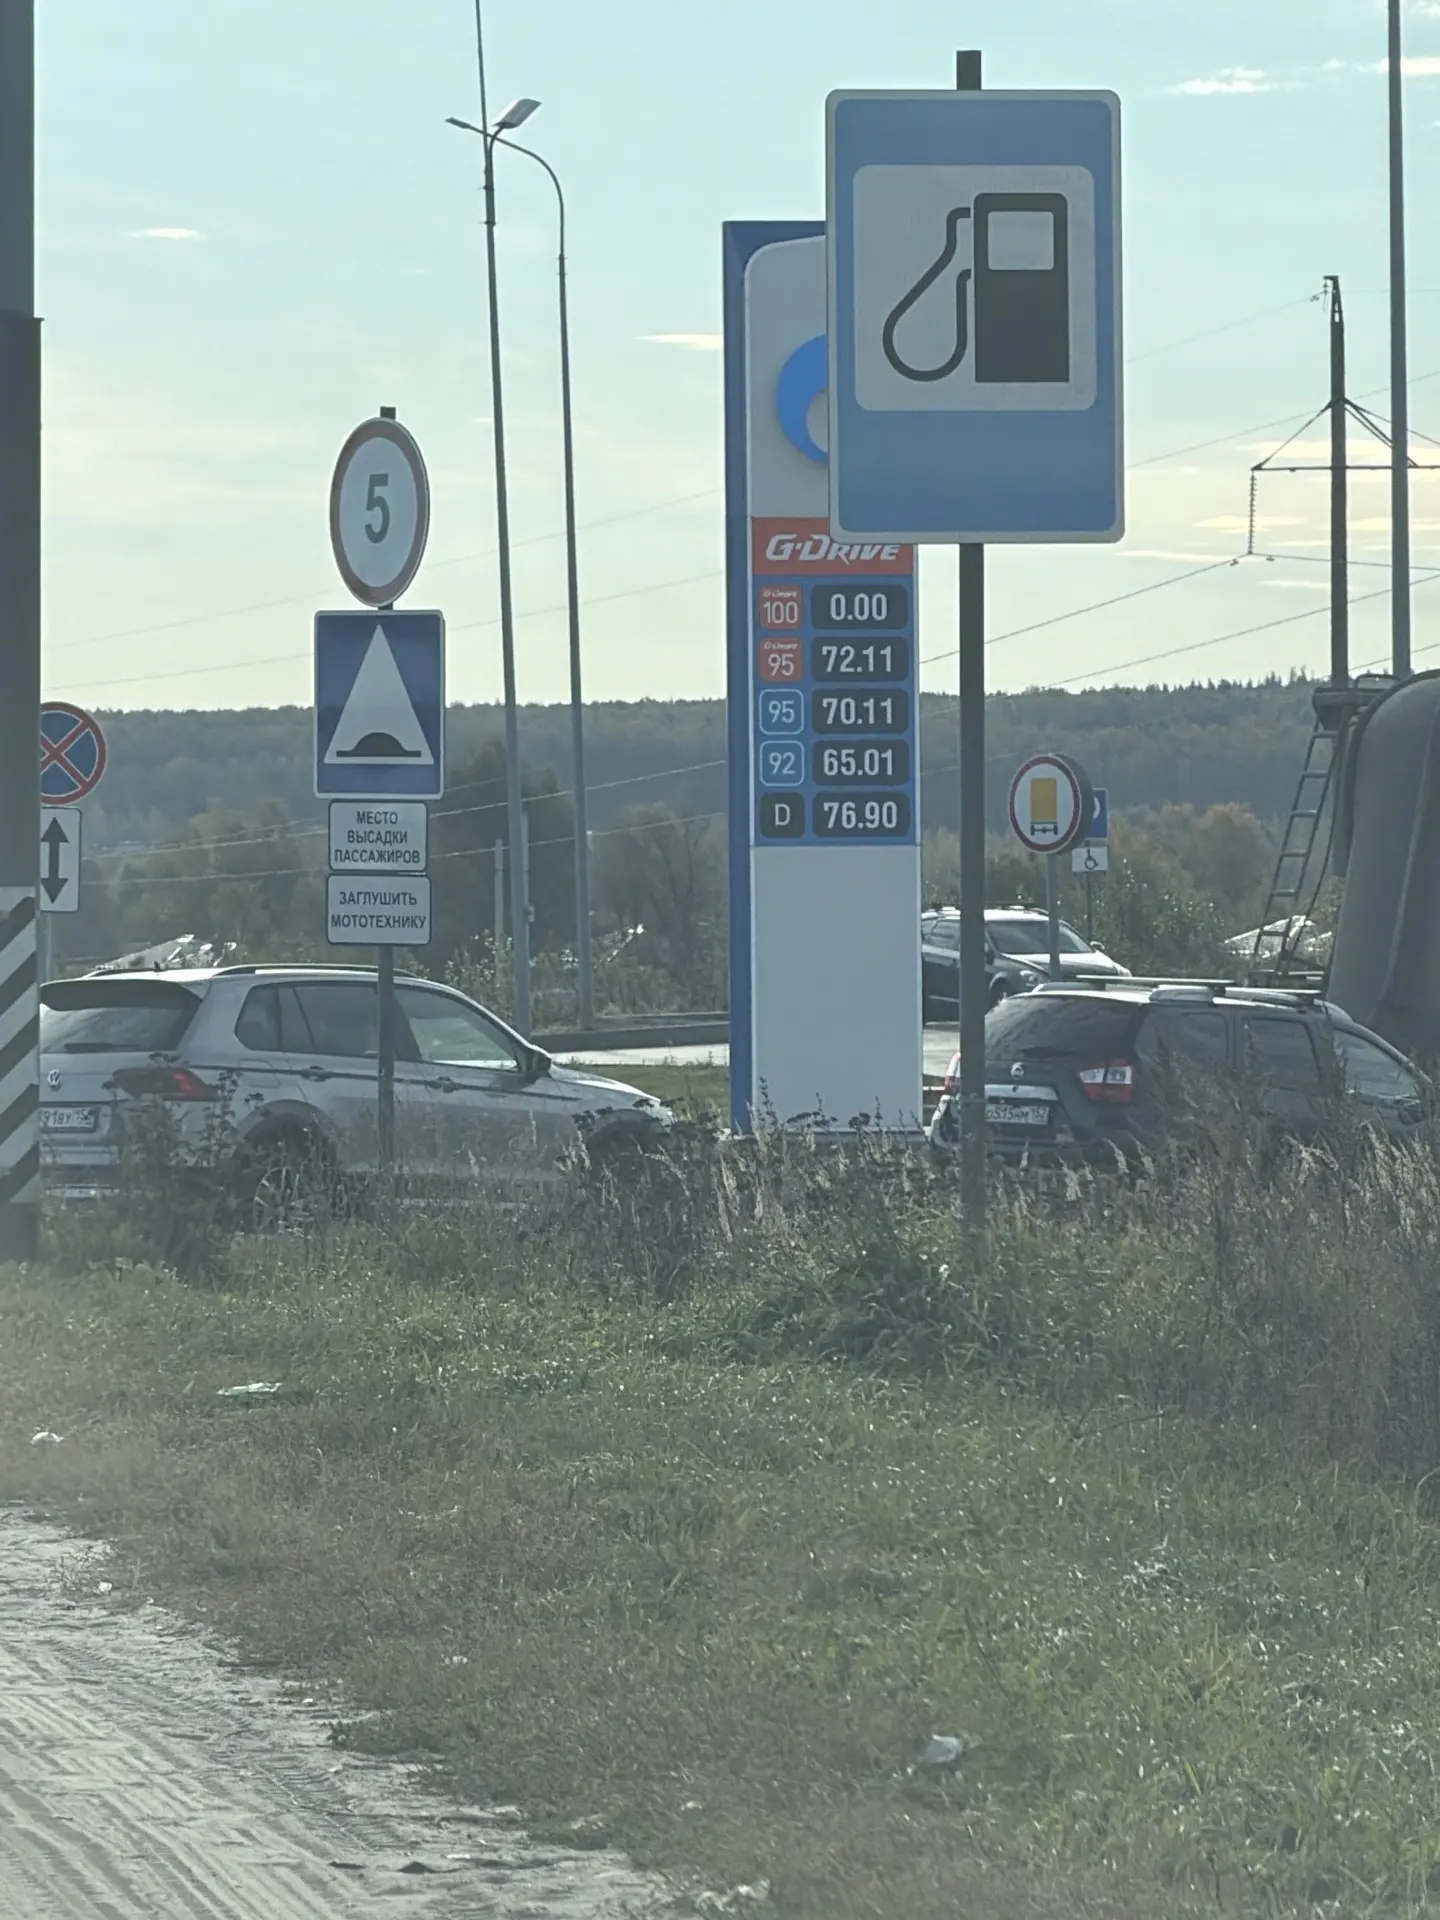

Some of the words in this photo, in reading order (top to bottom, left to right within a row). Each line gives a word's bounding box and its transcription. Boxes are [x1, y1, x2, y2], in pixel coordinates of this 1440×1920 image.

[364, 473, 391, 544] 5
[763, 601, 798, 624] 100
[830, 593, 888, 621] 0.00
[768, 654, 794, 677] 95
[822, 646, 893, 673] 72.11
[768, 700, 795, 724] 95
[822, 698, 893, 725] 70.11
[769, 752, 796, 775] 92
[823, 749, 894, 776] 65.01
[356, 811, 398, 825] МЕСТО
[774, 804, 791, 826] D
[823, 802, 897, 829] 76.90
[347, 830, 408, 846] ВЫСАДКИ
[334, 849, 420, 863] ПАССАЖИРОВ
[339, 891, 418, 905] ЗАГЛУШИТЬ
[331, 914, 426, 928] МОТОТЕХНИКУ
